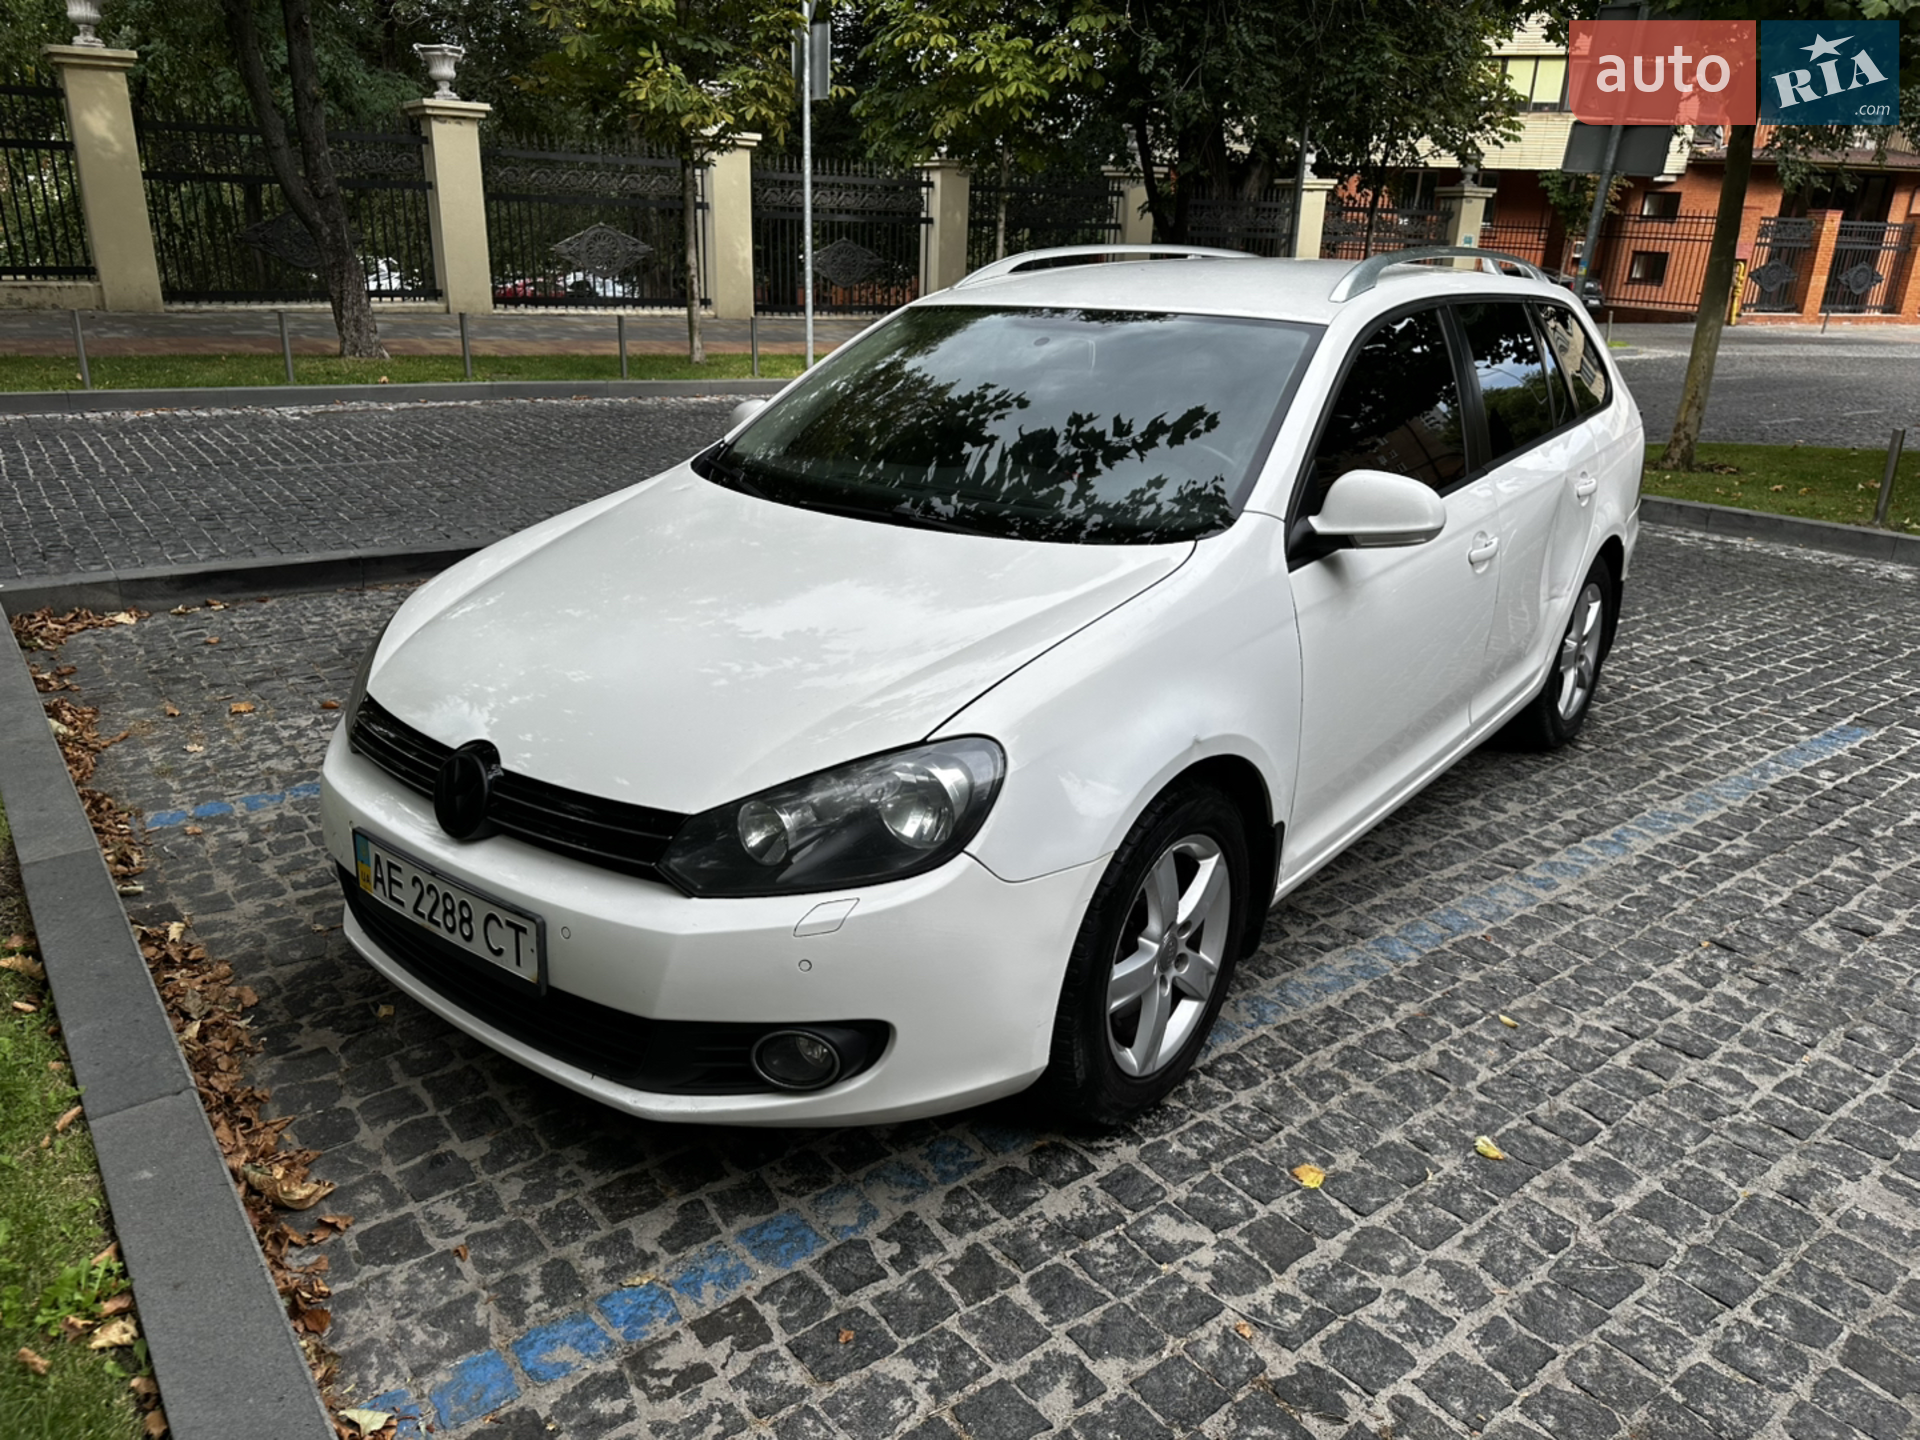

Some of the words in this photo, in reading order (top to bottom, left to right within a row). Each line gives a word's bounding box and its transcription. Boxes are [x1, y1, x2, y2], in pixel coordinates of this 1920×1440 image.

[360, 870, 371, 885] UA
[373, 852, 405, 908] AE
[411, 875, 474, 943] 2288
[483, 912, 528, 968] CT
